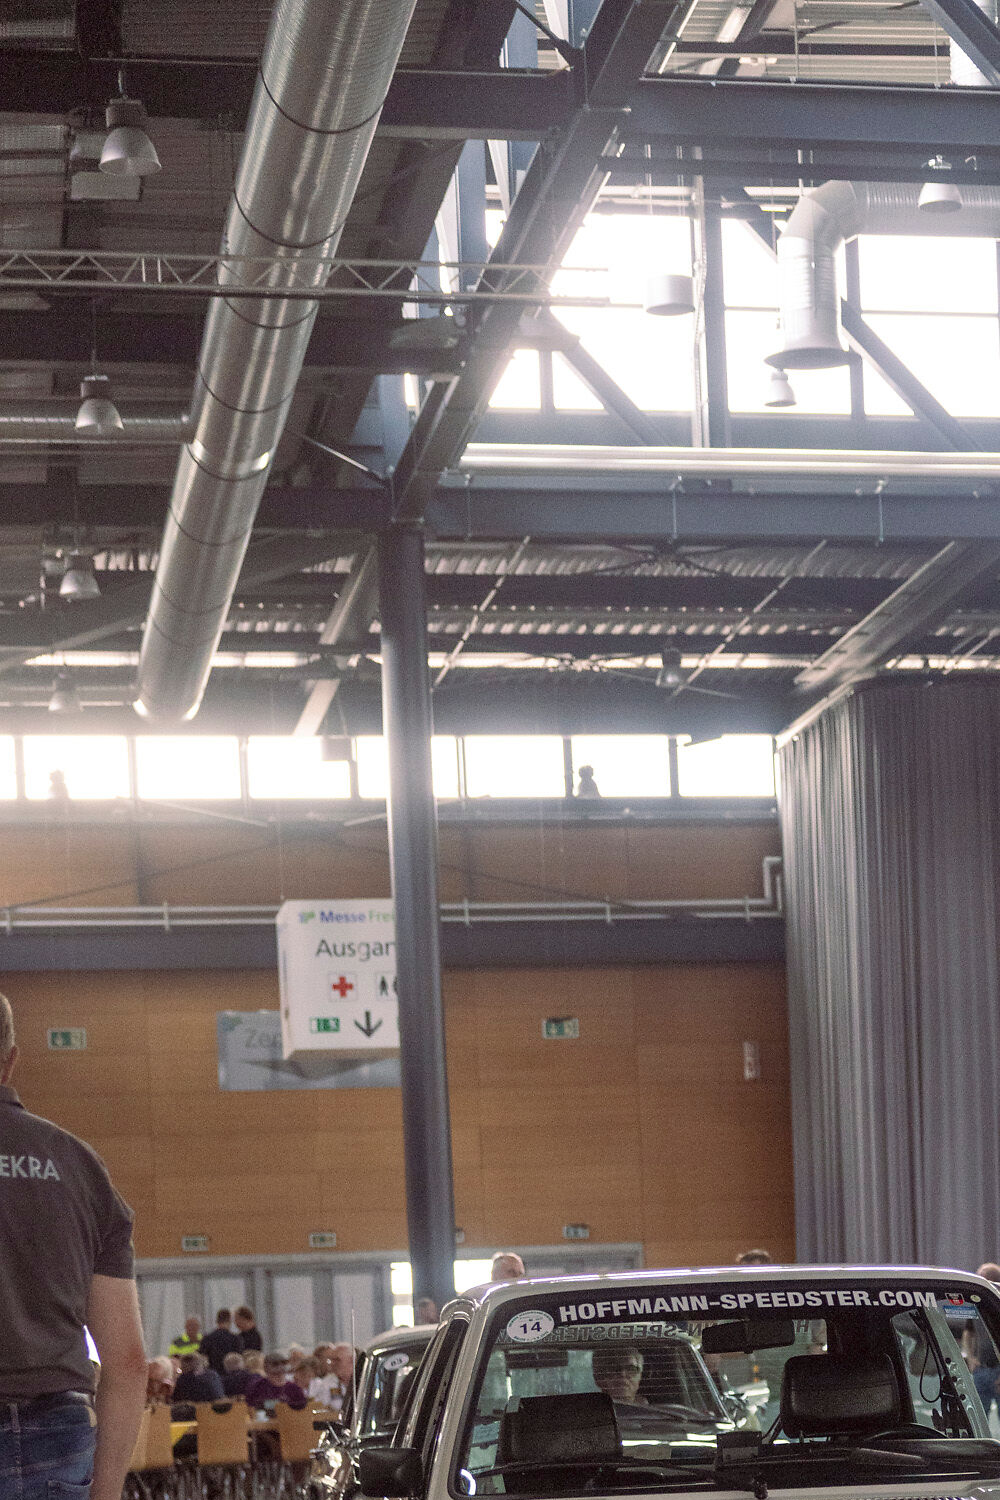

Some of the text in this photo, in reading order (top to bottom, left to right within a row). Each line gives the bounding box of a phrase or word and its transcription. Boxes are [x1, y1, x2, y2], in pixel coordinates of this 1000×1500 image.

[320, 910, 396, 923] Messe Frei
[0, 1155, 61, 1181] EKRA
[558, 1290, 939, 1323] HOFFMANN-SPEEDSTER.COM
[520, 1321, 543, 1334] 14
